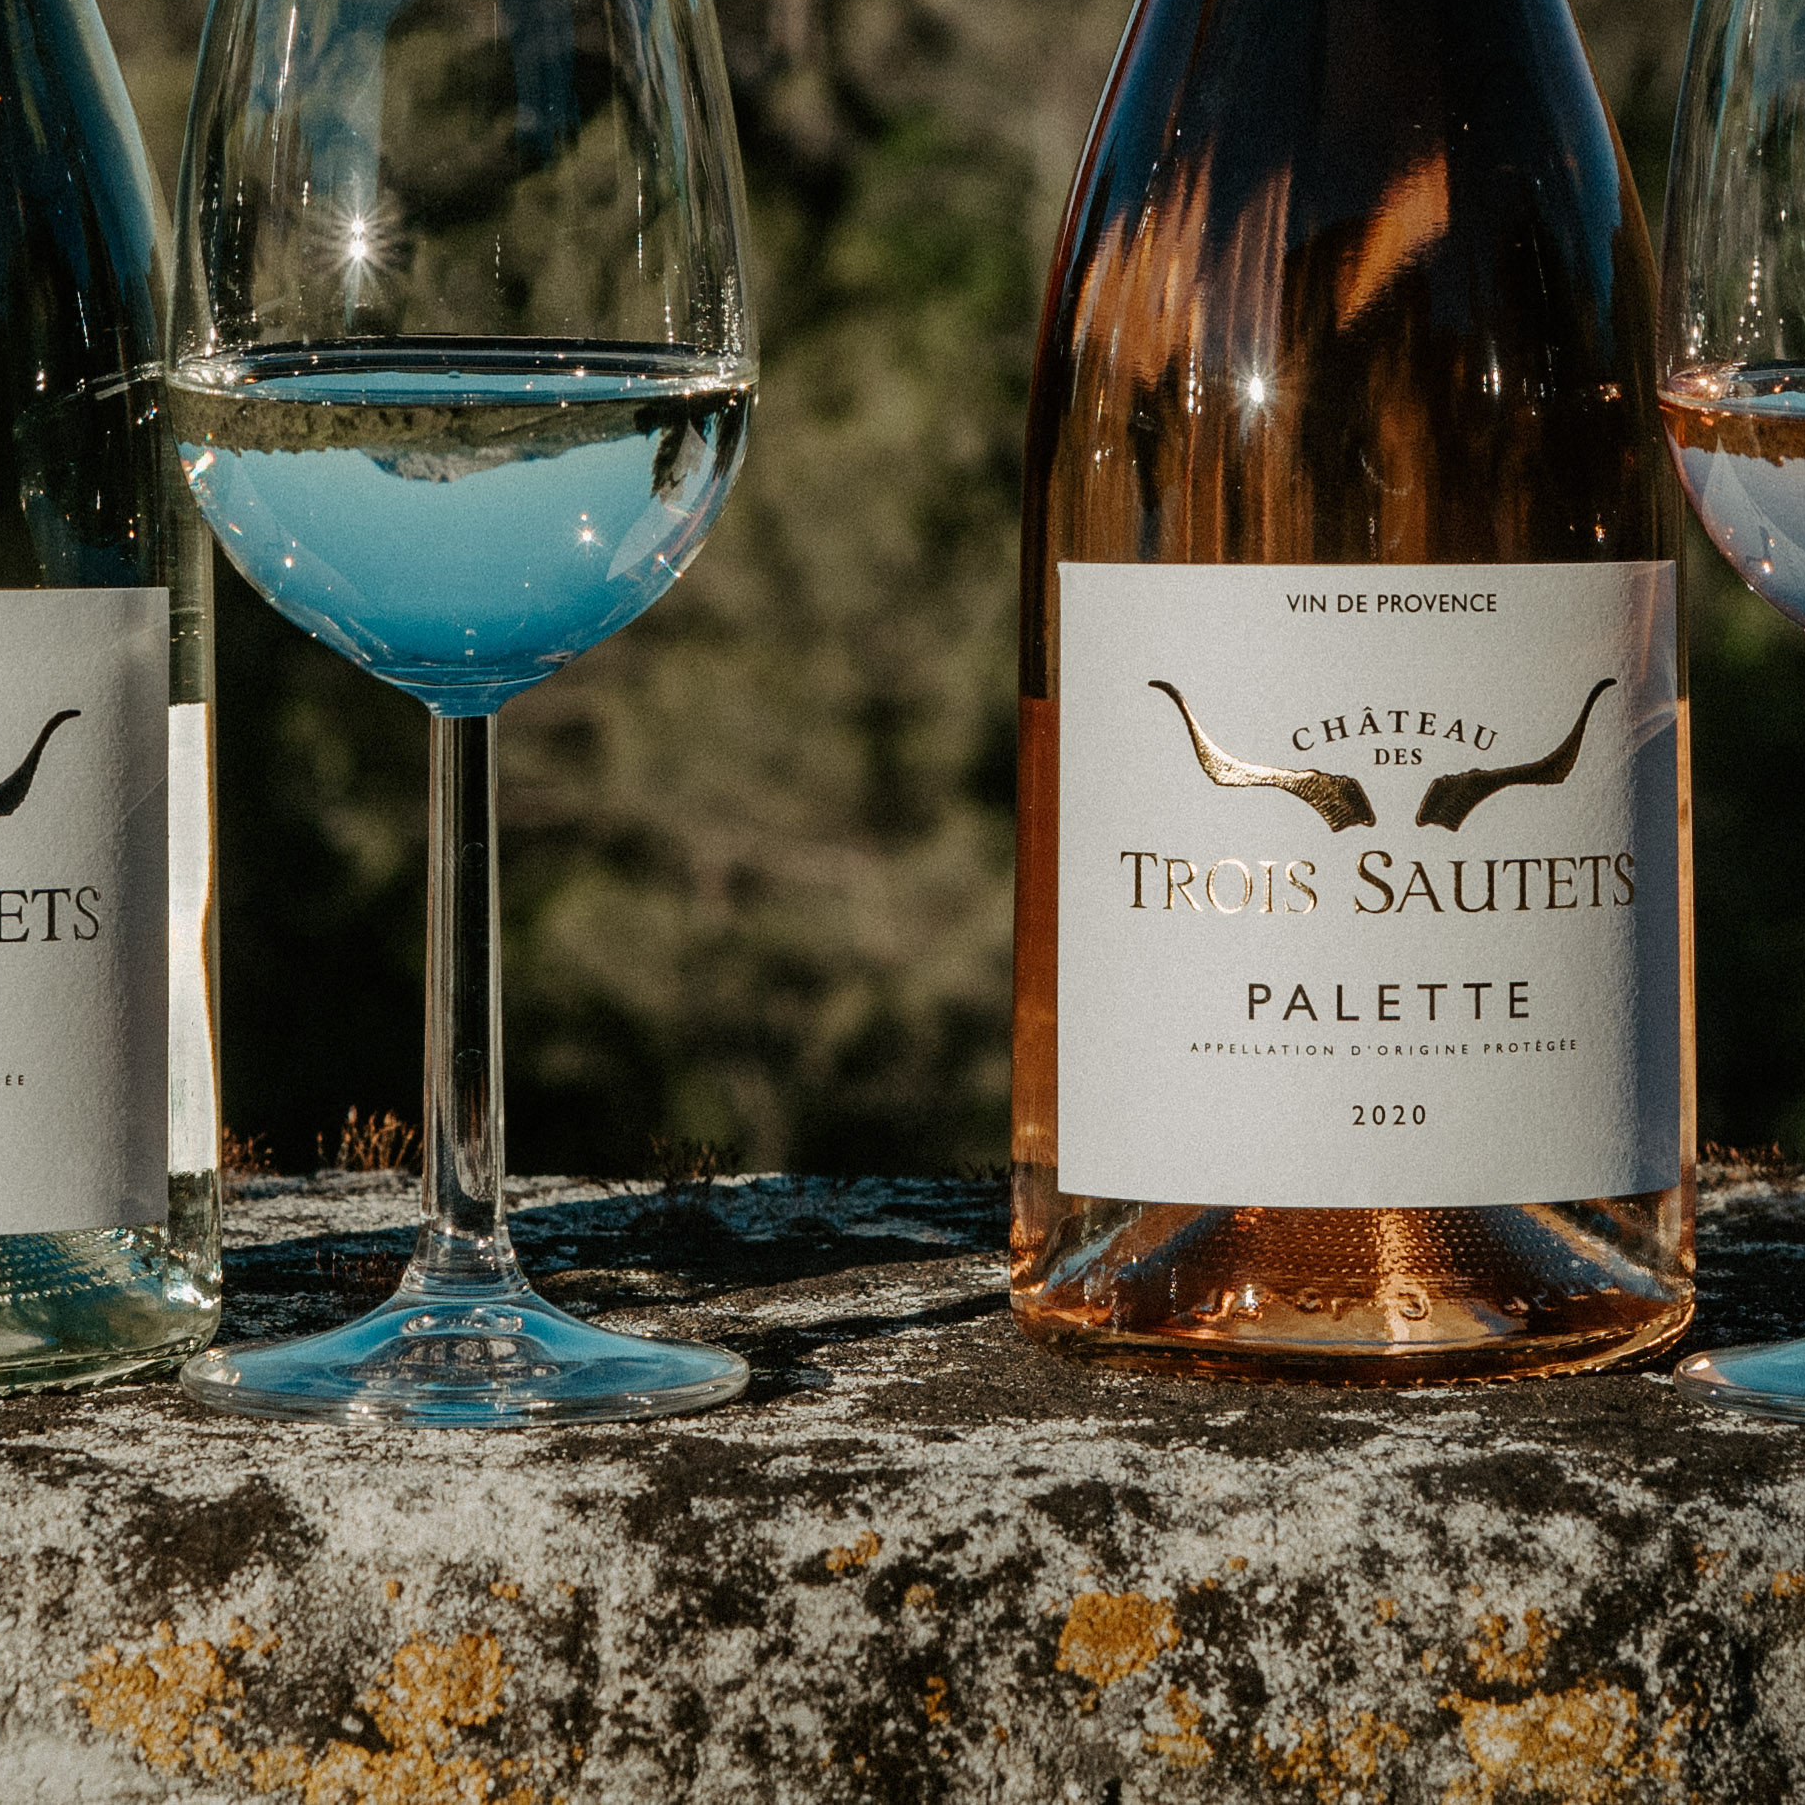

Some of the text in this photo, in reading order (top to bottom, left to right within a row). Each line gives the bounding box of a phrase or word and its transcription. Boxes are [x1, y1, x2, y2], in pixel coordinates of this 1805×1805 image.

[1286, 593, 1497, 614] VIN DE PROVENCE
[1291, 705, 1499, 753] CHÂTEAU
[1374, 747, 1423, 767] DES
[1119, 849, 1638, 914] TROIS SAUTETS
[1247, 980, 1531, 1022] PALETTE
[1190, 1038, 1578, 1057] APPELLATION D'ORIGINE PROTÉGÉE
[1351, 1104, 1428, 1127] 2020
